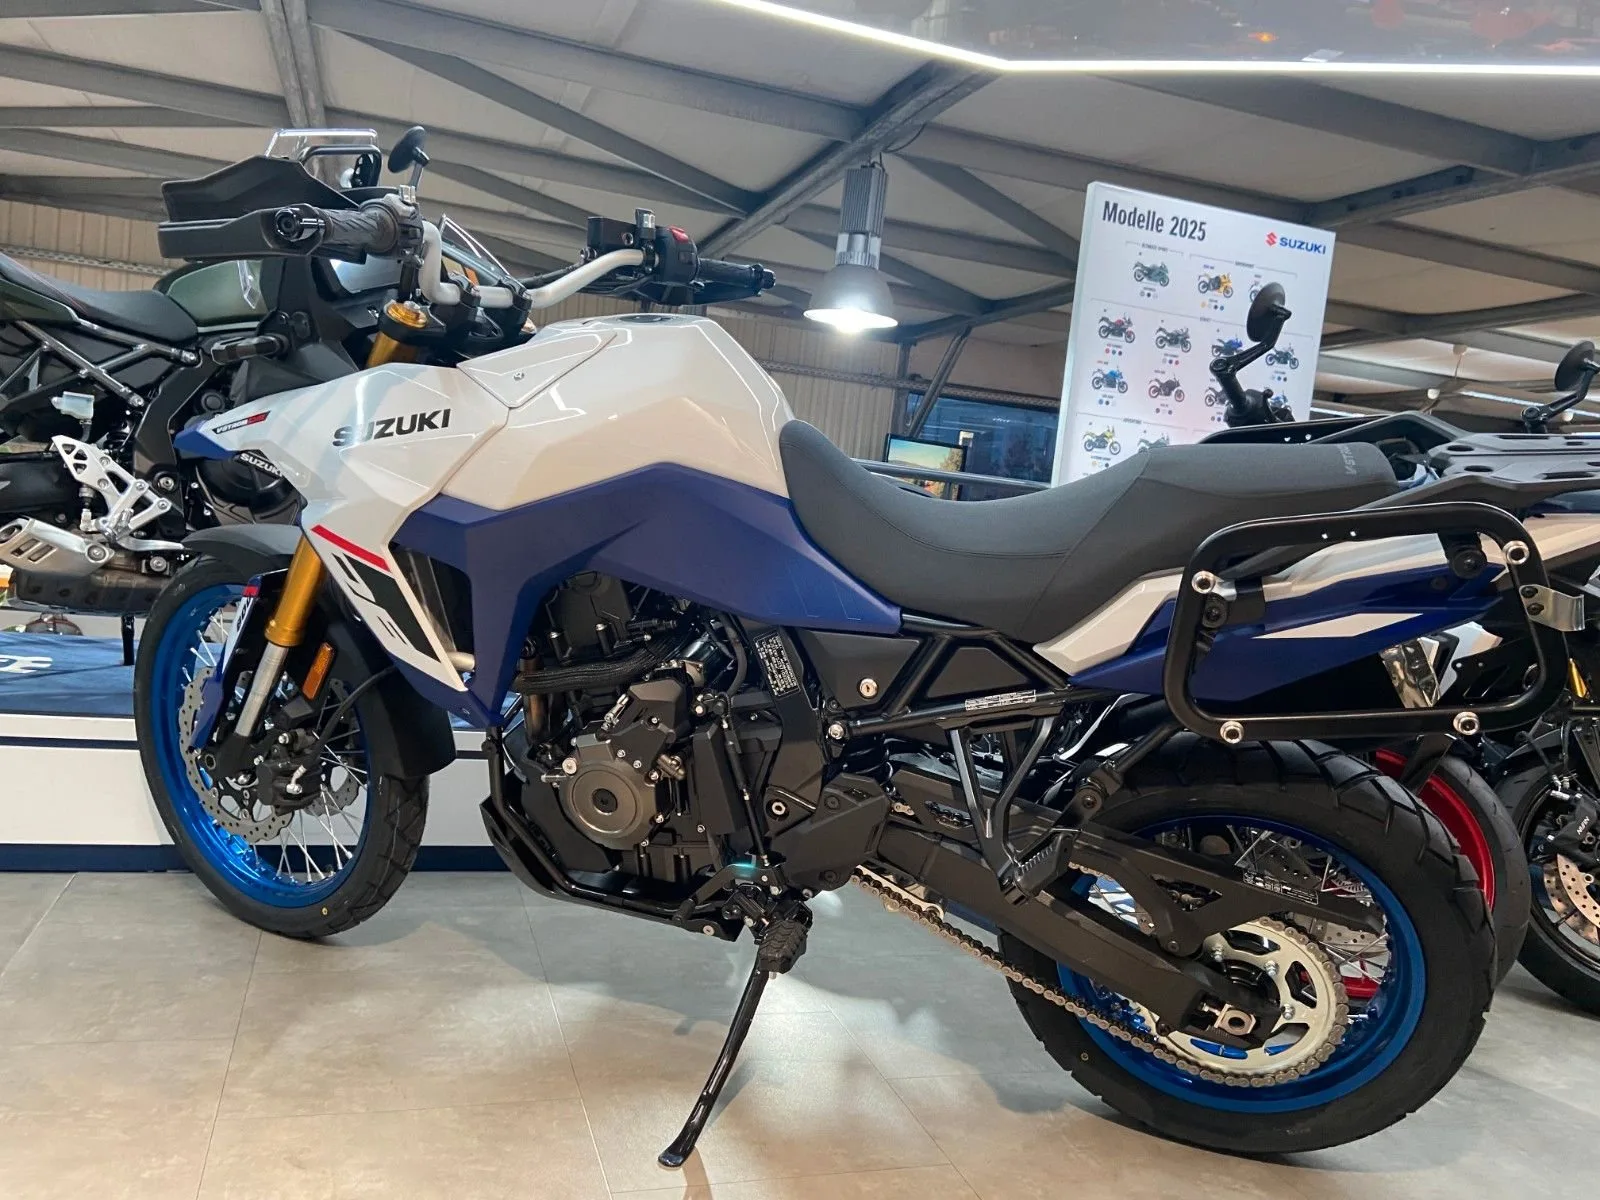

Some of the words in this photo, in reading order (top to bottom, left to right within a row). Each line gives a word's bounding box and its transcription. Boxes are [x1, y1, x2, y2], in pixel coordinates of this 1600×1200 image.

[1102, 200, 1165, 233] Modelle
[1169, 216, 1207, 242] 2025
[1279, 236, 1327, 255] SUZUKI
[332, 408, 451, 447] SUZUKI
